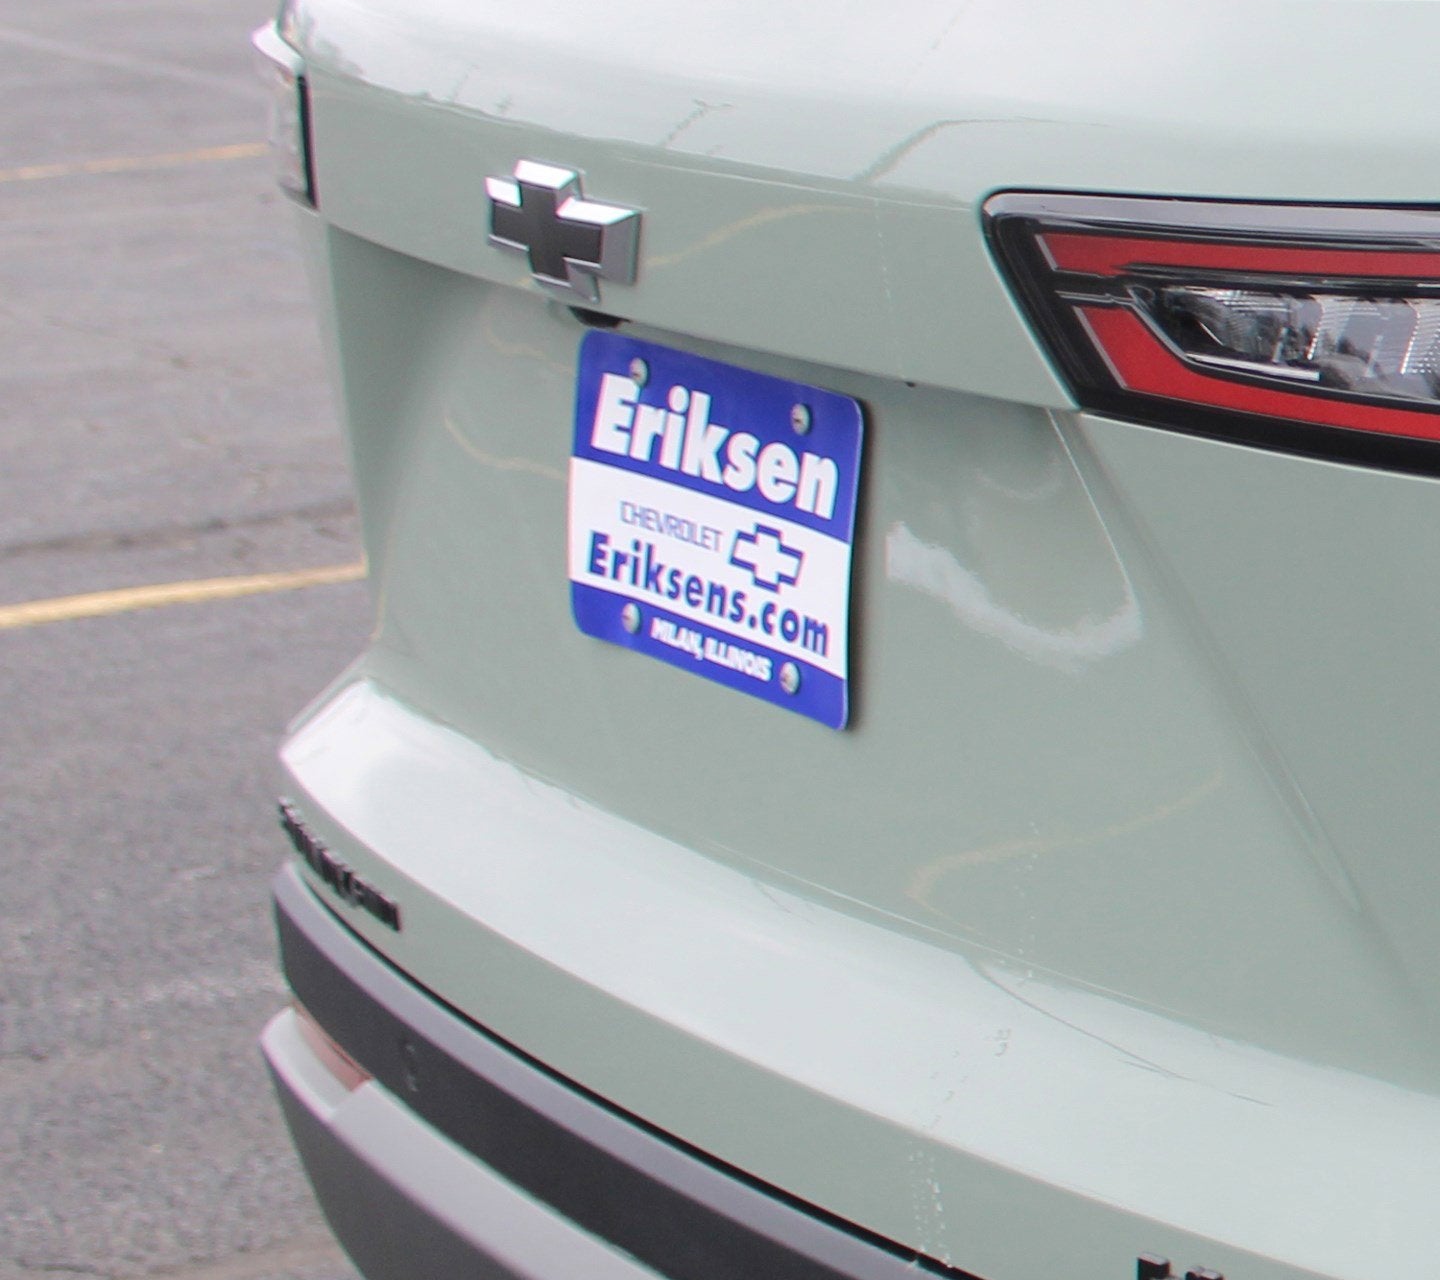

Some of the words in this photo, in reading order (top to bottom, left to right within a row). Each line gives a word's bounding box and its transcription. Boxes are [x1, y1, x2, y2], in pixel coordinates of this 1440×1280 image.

[590, 372, 840, 520] Eriksen
[619, 500, 724, 554] CHEVROLET
[587, 529, 829, 658] Eriksens.com
